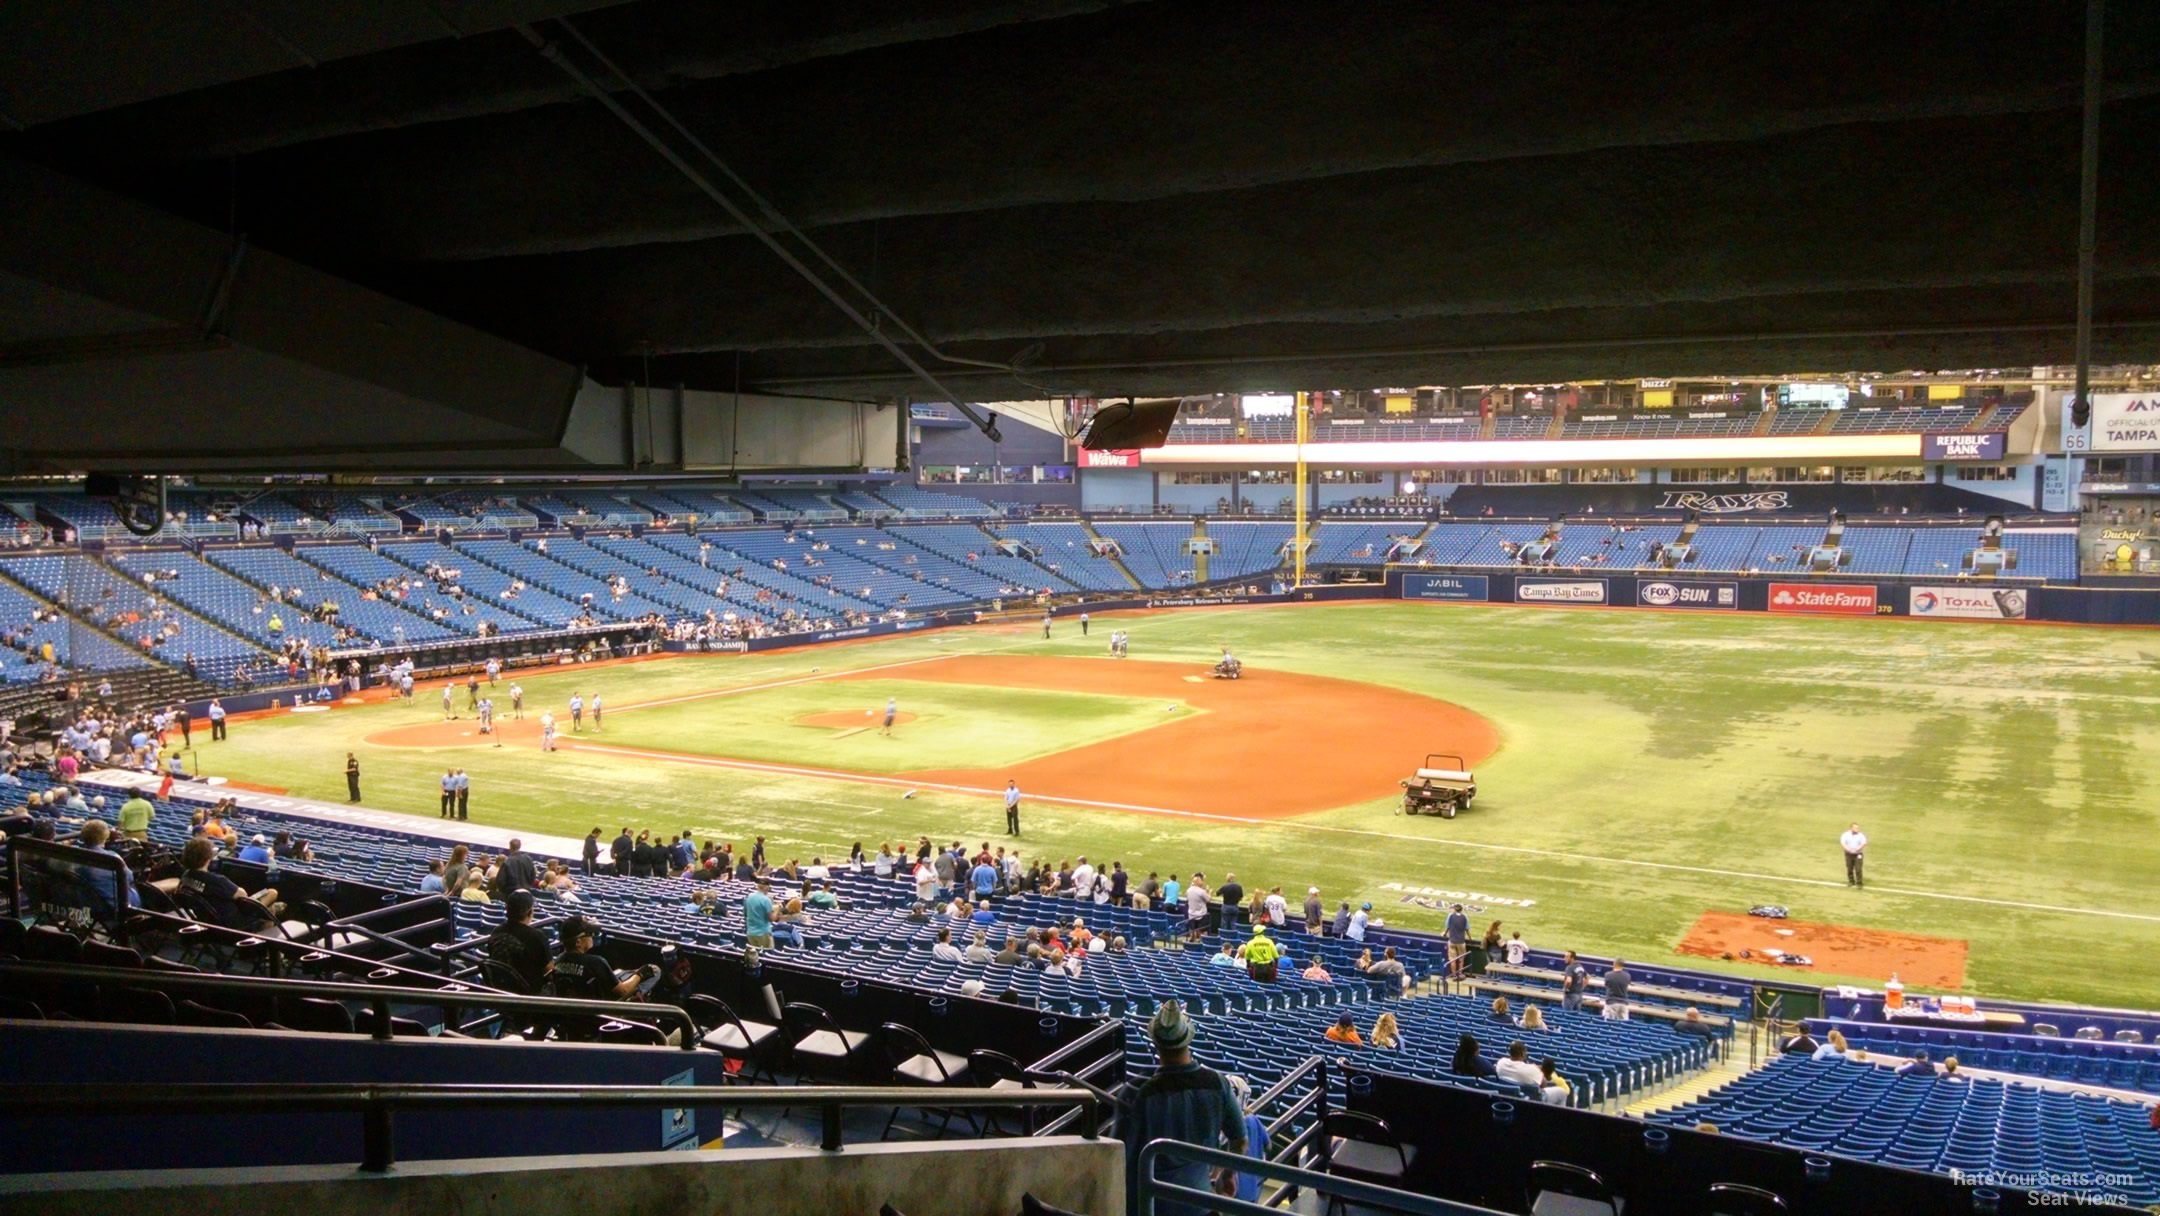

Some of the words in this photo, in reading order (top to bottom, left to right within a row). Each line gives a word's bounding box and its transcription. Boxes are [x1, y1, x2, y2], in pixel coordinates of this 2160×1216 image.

[2107, 418, 2148, 427] OFFICIAL
[1936, 435, 1990, 446] REPUBLIC
[2106, 430, 2158, 441] TAMPA
[2066, 435, 2085, 448] 66
[1947, 445, 1979, 455] BANK
[1088, 453, 1128, 466] Wawa
[1655, 491, 1788, 513] RAYS
[1427, 580, 1463, 588] JABIL
[1523, 587, 1552, 598] Tampa
[1553, 587, 1571, 598] Bay
[1572, 587, 1600, 597] Times
[1650, 587, 1671, 596] FOX
[1680, 588, 1710, 602] SUN
[1943, 597, 1993, 607] TOTAL
[1877, 605, 1893, 613] 370
